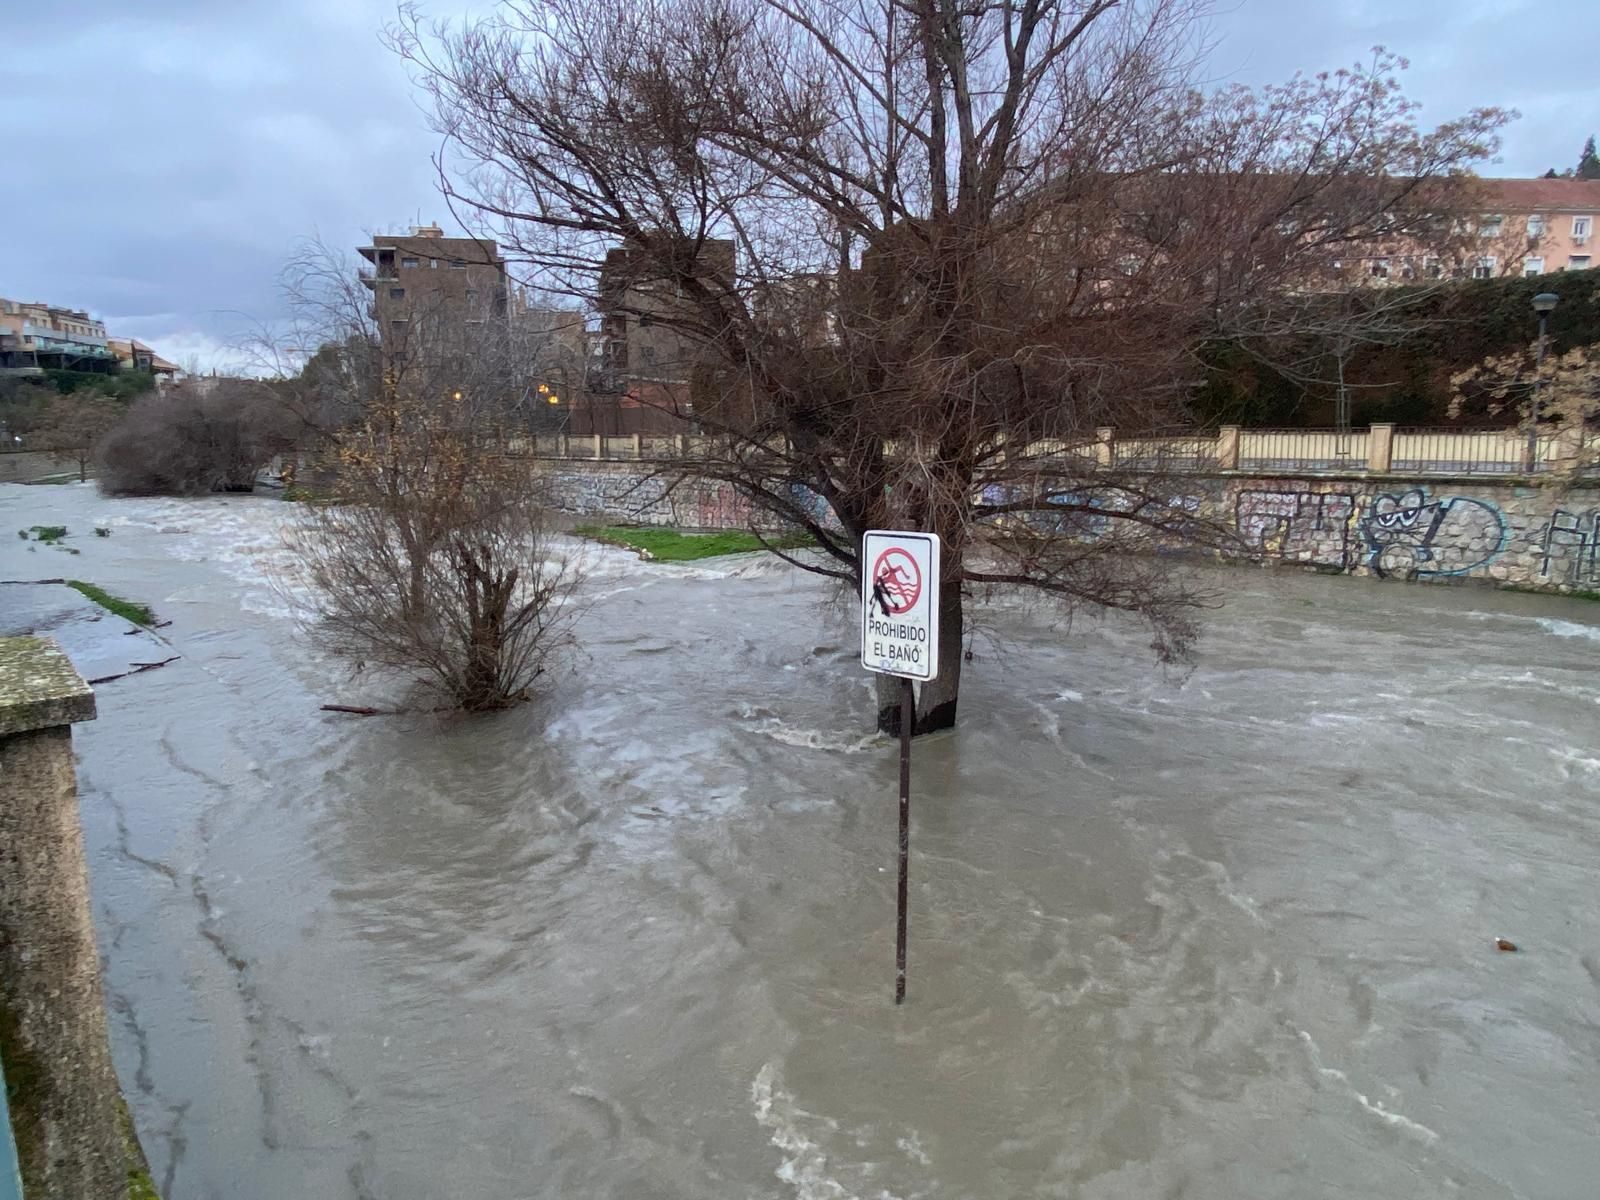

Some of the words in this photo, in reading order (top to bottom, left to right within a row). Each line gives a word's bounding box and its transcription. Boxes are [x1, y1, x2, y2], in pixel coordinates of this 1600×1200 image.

[869, 620, 926, 642] PROHIBIDO
[874, 642, 886, 658] EL
[889, 643, 920, 663] BAÑO
